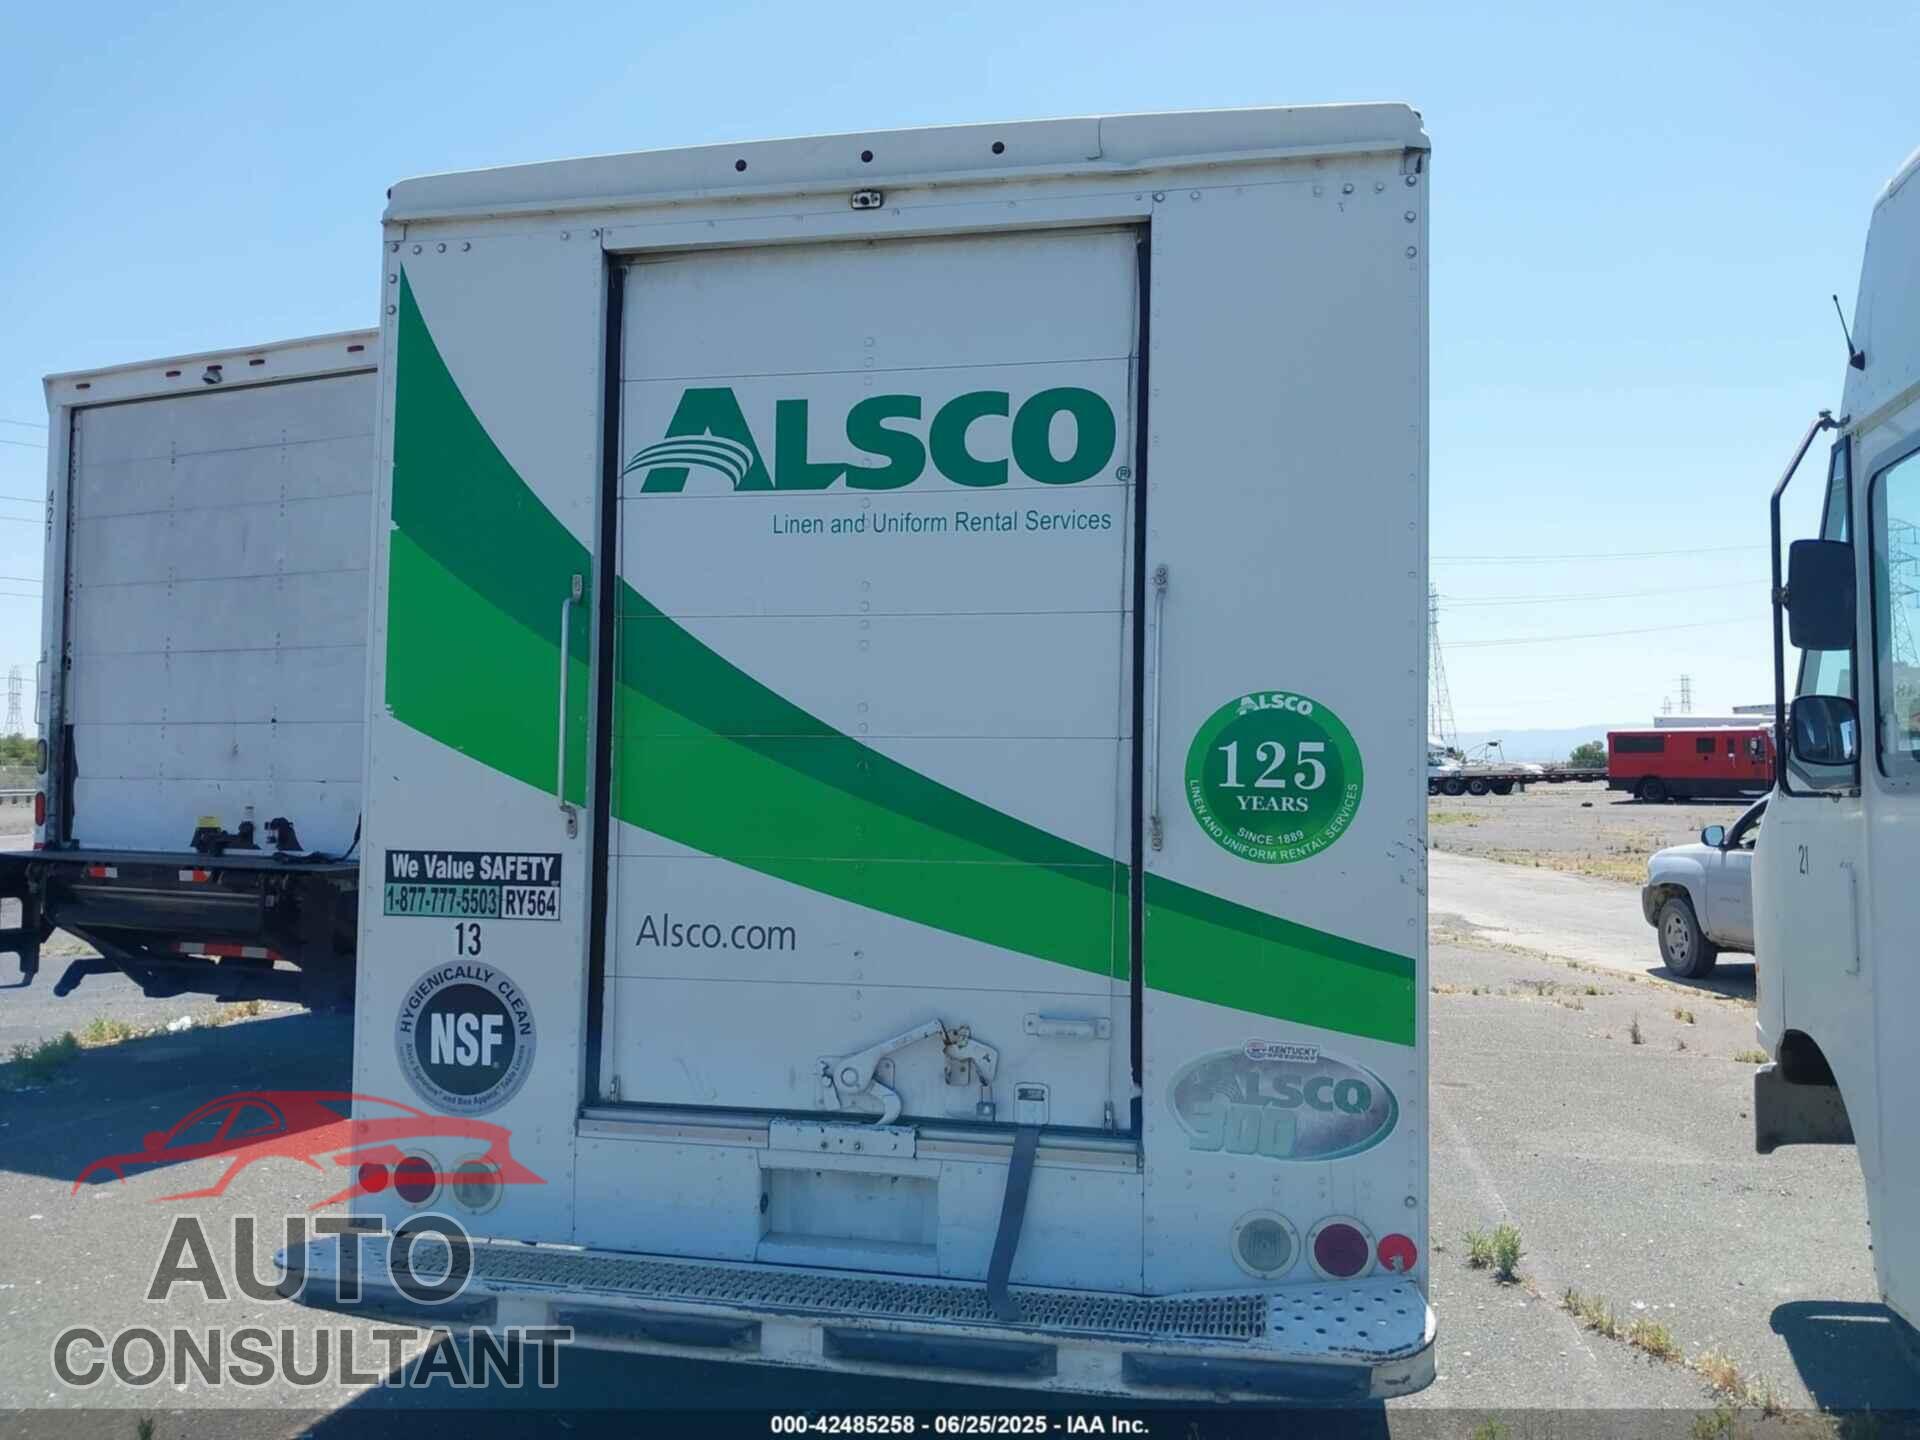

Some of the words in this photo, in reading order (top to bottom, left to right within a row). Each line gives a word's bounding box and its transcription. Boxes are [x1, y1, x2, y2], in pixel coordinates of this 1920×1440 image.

[619, 387, 1117, 492] ALSCO
[773, 514, 824, 534] Linen
[831, 513, 866, 533] and
[873, 512, 947, 533] Uniform
[955, 511, 1018, 531] Rental
[1025, 509, 1112, 531] Services
[1237, 693, 1313, 716] ALSCO
[1217, 740, 1326, 790] 125
[1189, 779, 1207, 815] LINEN
[1202, 814, 1223, 838] AND
[1222, 836, 1277, 860] UNIFORM
[1280, 837, 1327, 860] RENTAL
[1326, 783, 1358, 838] SERVICES
[1236, 795, 1309, 812] YEARS
[1237, 827, 1273, 845] SINCE
[1278, 830, 1304, 844] 1889
[392, 854, 419, 878] We
[424, 854, 475, 880] Value
[479, 855, 554, 881] SAFETY
[386, 885, 497, 914] 1-877-777-5503
[505, 889, 556, 916] RY564
[455, 922, 482, 956] 13
[635, 913, 796, 950] Alsco.com
[400, 965, 495, 1033] HYGIENICALLY
[498, 981, 532, 1035] CLEAN
[430, 1012, 503, 1067] NSF
[1190, 1062, 1372, 1114] ALSCO
